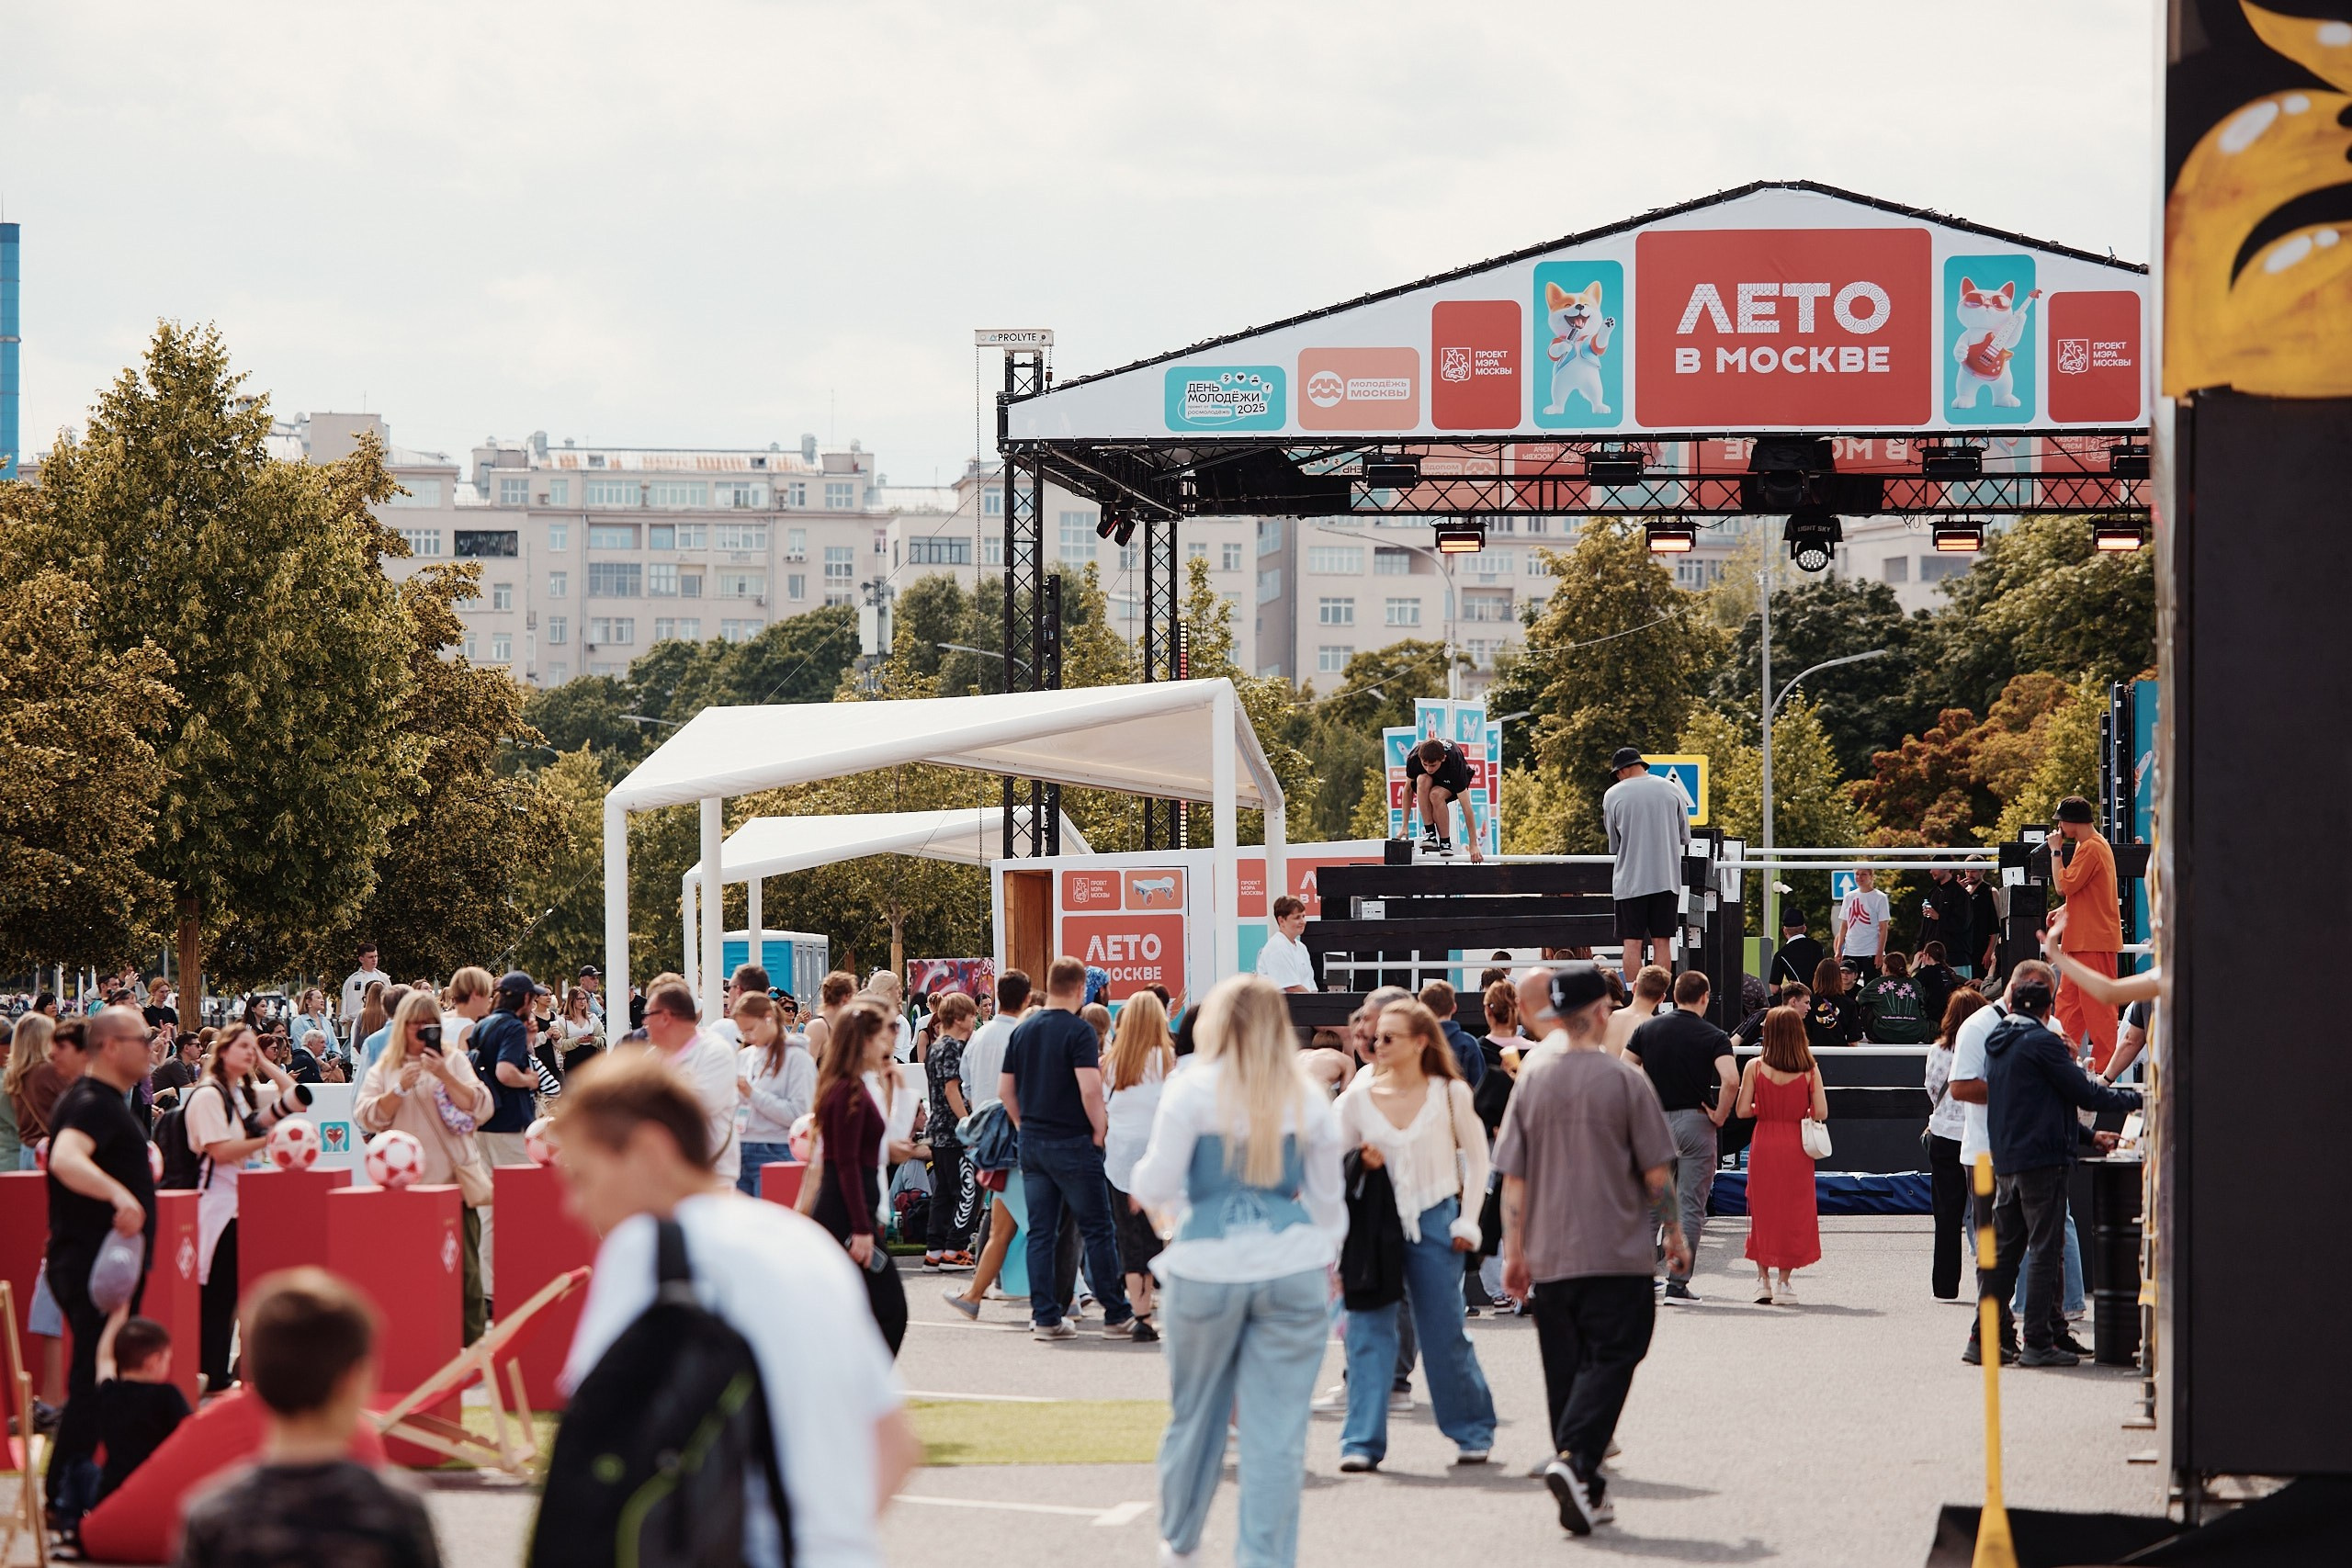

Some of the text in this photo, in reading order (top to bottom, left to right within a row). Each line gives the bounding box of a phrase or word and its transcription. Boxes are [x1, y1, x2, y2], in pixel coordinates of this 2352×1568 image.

[1676, 281, 1891, 334] ЛЕТО
[998, 333, 1036, 341] PROLYTE
[1676, 346, 1890, 373] В МОСКВЕ
[1188, 383, 1220, 393] ДЕНЬ
[1188, 390, 1260, 403] МОЛОДЁЖИ
[1238, 403, 1265, 414] 2025
[1085, 933, 1161, 962] ЛЕТО
